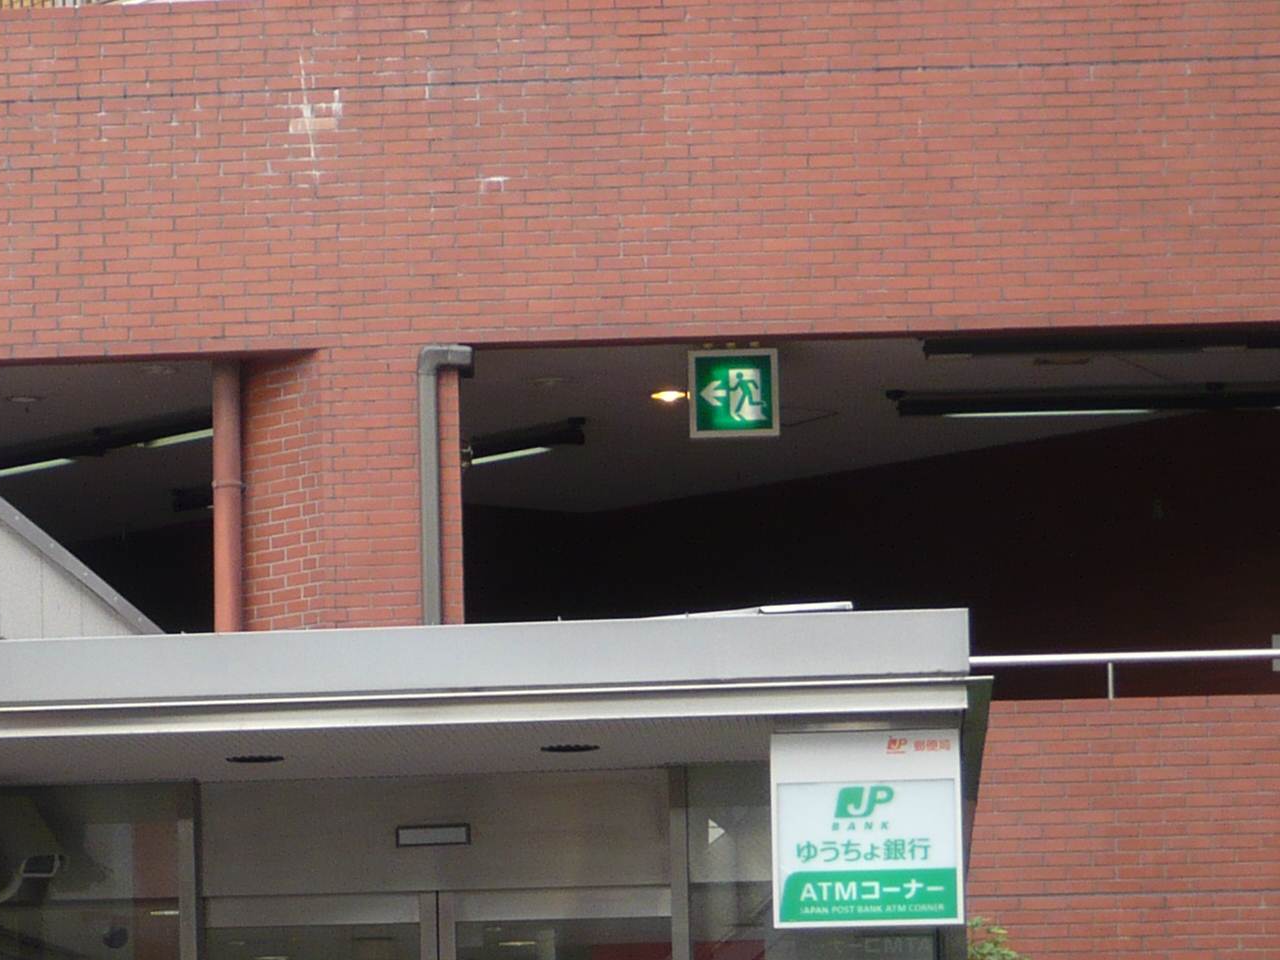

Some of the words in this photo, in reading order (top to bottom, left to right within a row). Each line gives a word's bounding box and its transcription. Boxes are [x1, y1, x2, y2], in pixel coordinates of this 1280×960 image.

[834, 785, 895, 818] JP
[831, 821, 890, 831] BANK
[795, 838, 932, 863] ゆうちょ銀行
[799, 878, 945, 902] ATMコーナー
[800, 905, 829, 914] JAPAN
[831, 905, 855, 913] POST
[857, 904, 883, 913] BANK
[885, 904, 907, 912] ATM
[908, 903, 945, 912] CORNER
